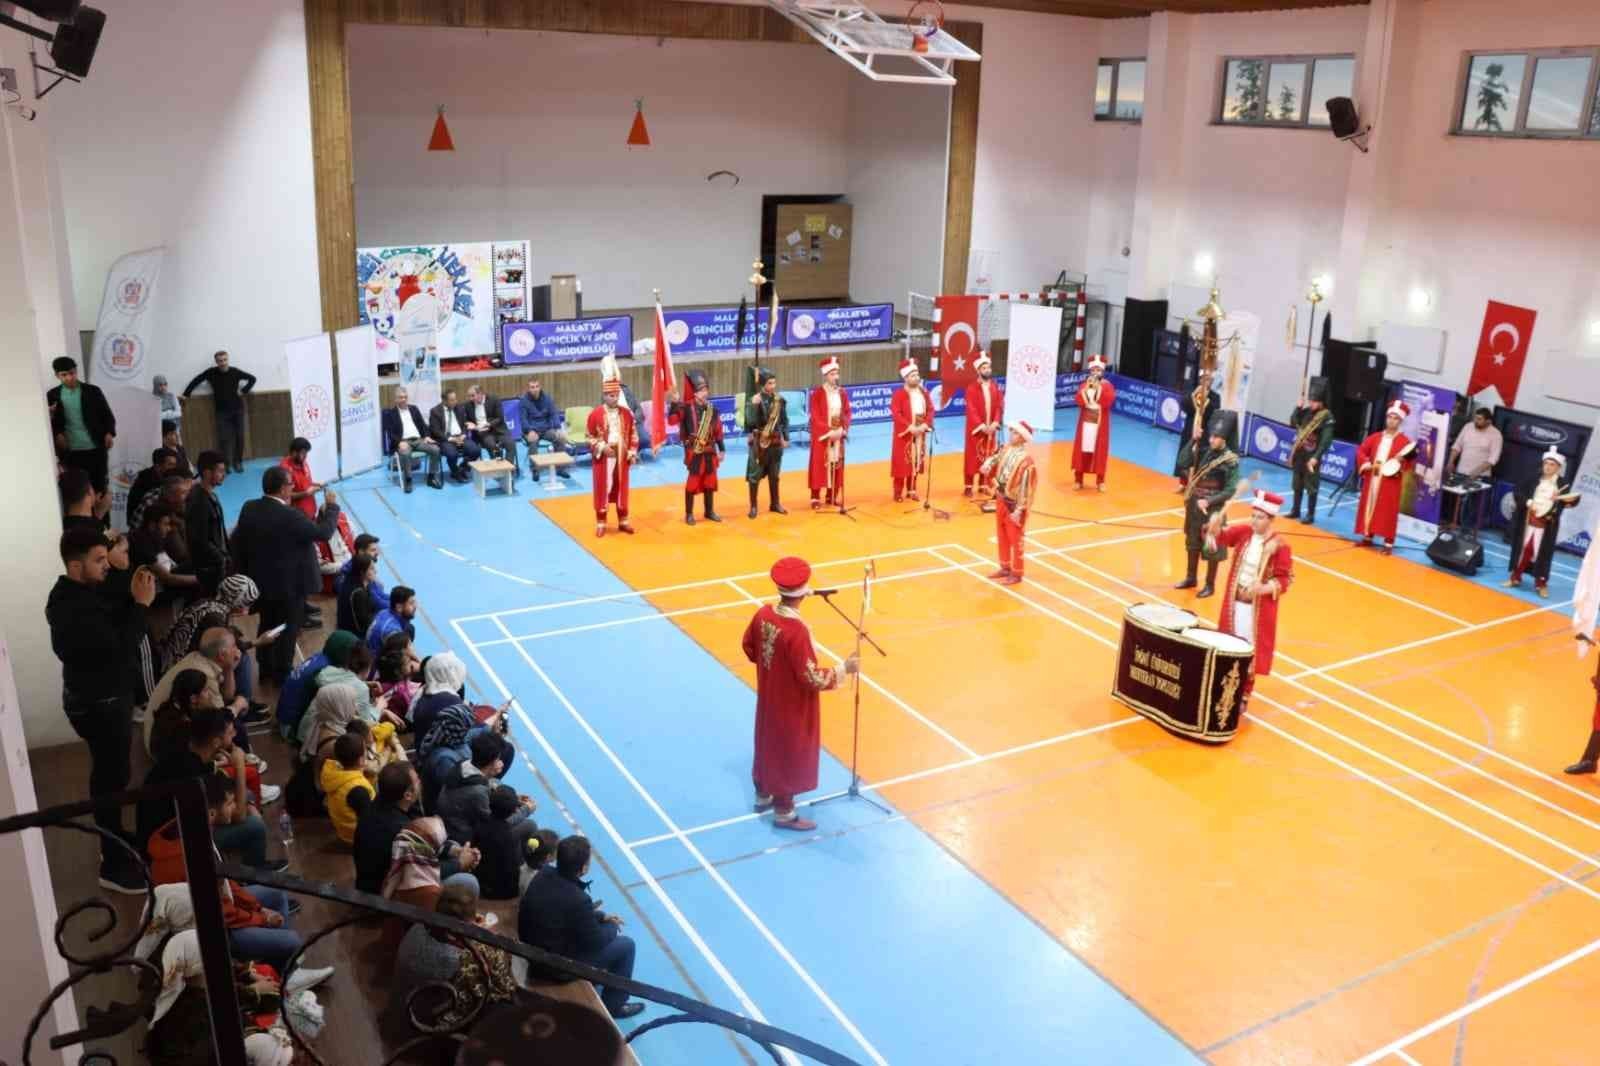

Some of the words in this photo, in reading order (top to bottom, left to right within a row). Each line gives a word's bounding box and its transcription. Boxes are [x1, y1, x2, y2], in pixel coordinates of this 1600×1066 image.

[714, 313, 754, 322] MALAYA
[828, 310, 870, 319] MALATYA
[555, 322, 602, 333] MALATYA
[693, 322, 735, 335] GENÇLİK
[540, 333, 580, 346] GENÇLİK
[594, 331, 618, 342] SPOR
[696, 335, 705, 347] İL
[543, 346, 553, 357] İL
[555, 343, 616, 357] MÜDÜRLÜĞÜ
[852, 388, 892, 399] MALATYA
